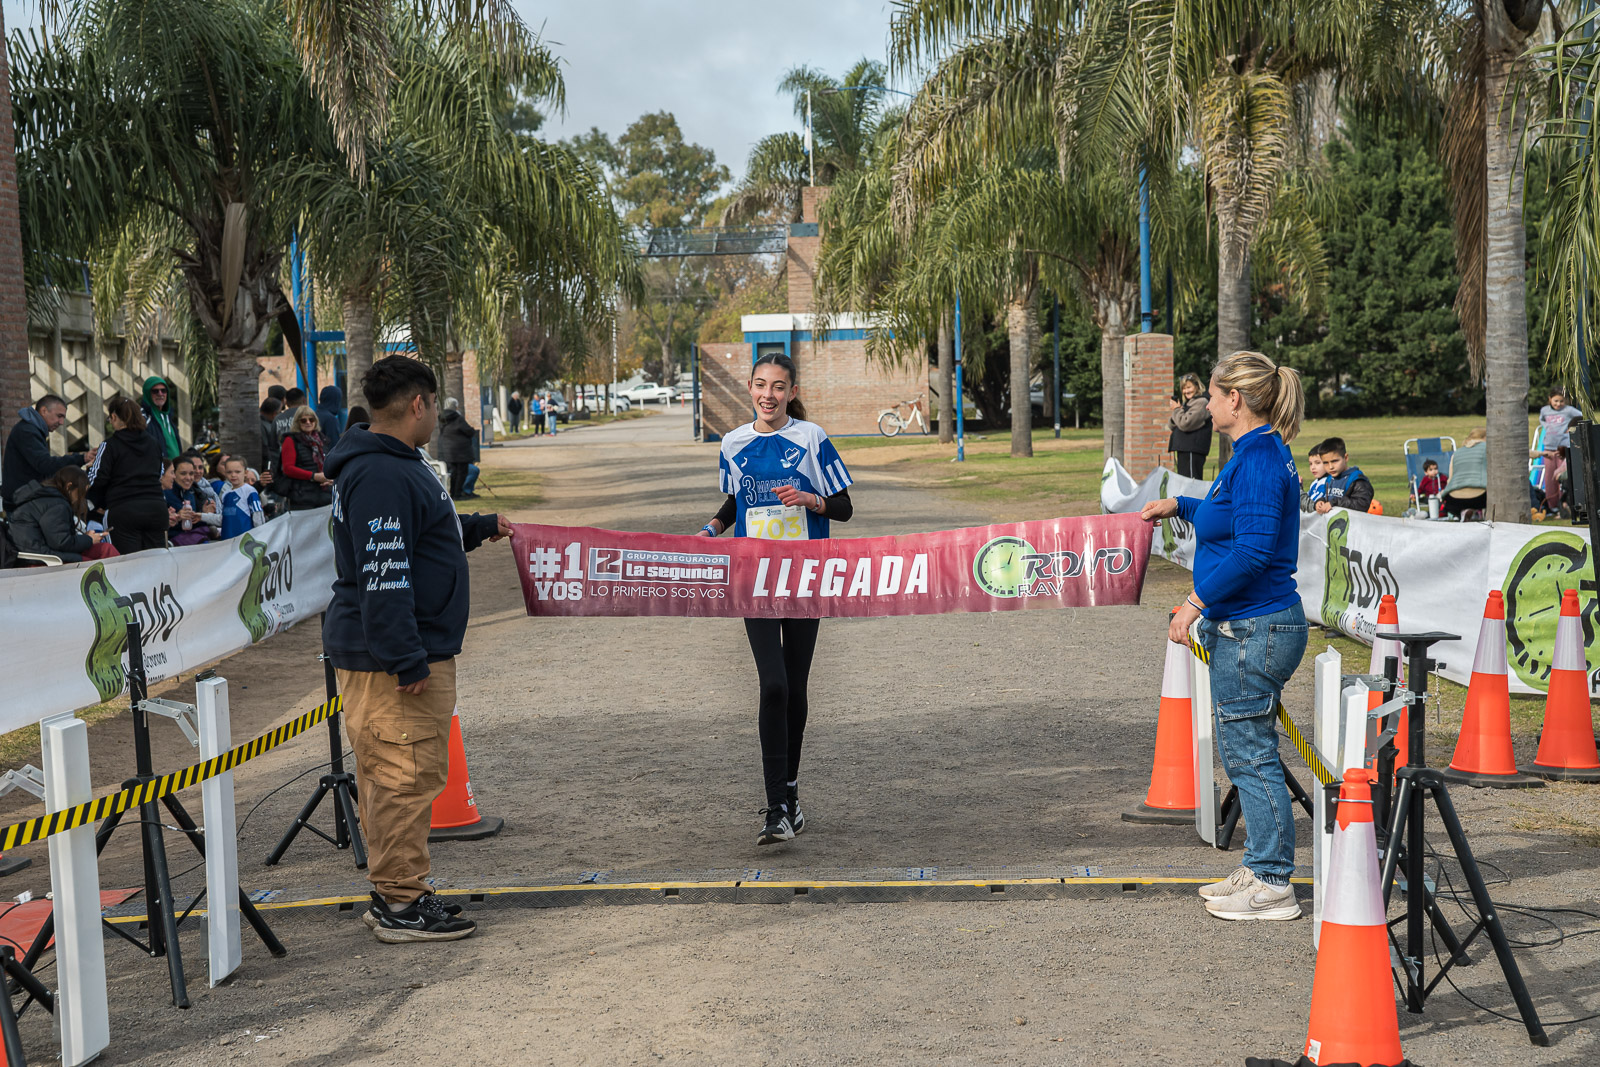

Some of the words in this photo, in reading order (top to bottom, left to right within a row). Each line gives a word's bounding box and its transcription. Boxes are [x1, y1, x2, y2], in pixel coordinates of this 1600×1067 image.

[368, 516, 382, 534] El
[383, 515, 401, 531] club
[752, 516, 802, 539] 703
[366, 537, 376, 552] de
[375, 535, 406, 557] pueblo
[363, 560, 379, 573] más
[529, 542, 583, 579] #1
[626, 552, 659, 562] GRUPO
[661, 554, 725, 564] ASEGURADOR
[647, 565, 724, 582] segunda
[752, 553, 928, 598] LLEGADA
[366, 577, 379, 592] del
[590, 585, 609, 597] LO
[612, 585, 667, 598] PRIMERO
[671, 587, 696, 599] SOS
[699, 588, 725, 599] VOS
[1017, 581, 1065, 597] RAV
